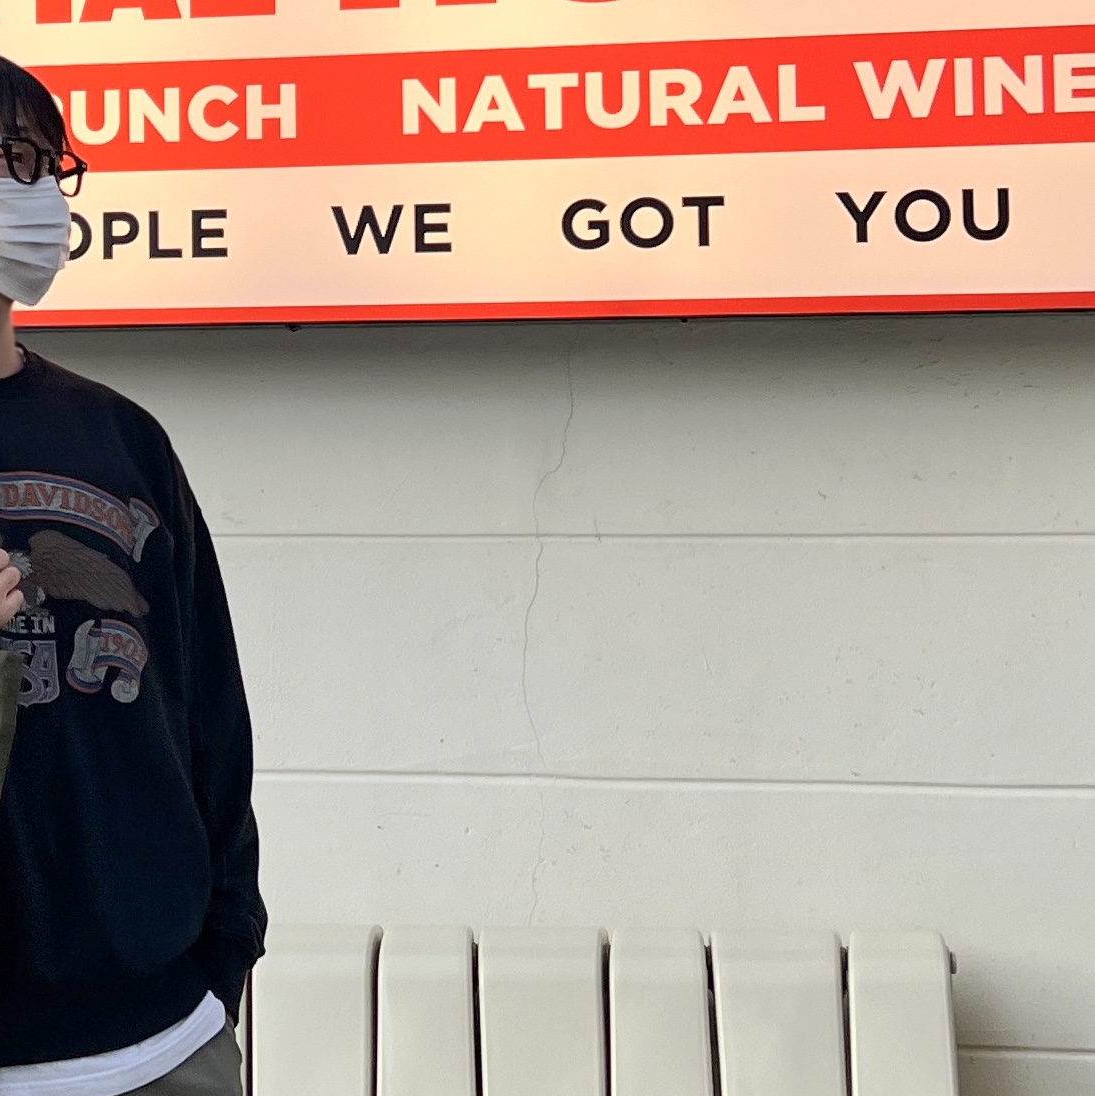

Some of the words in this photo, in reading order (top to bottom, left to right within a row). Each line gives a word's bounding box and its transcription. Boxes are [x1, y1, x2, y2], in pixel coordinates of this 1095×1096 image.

[53, 83, 297, 146] UNCH
[401, 64, 827, 135] NATURAL
[852, 53, 1095, 120] WINE
[332, 203, 452, 256] WE
[561, 195, 725, 251] GOT
[835, 187, 1010, 244] YOU
